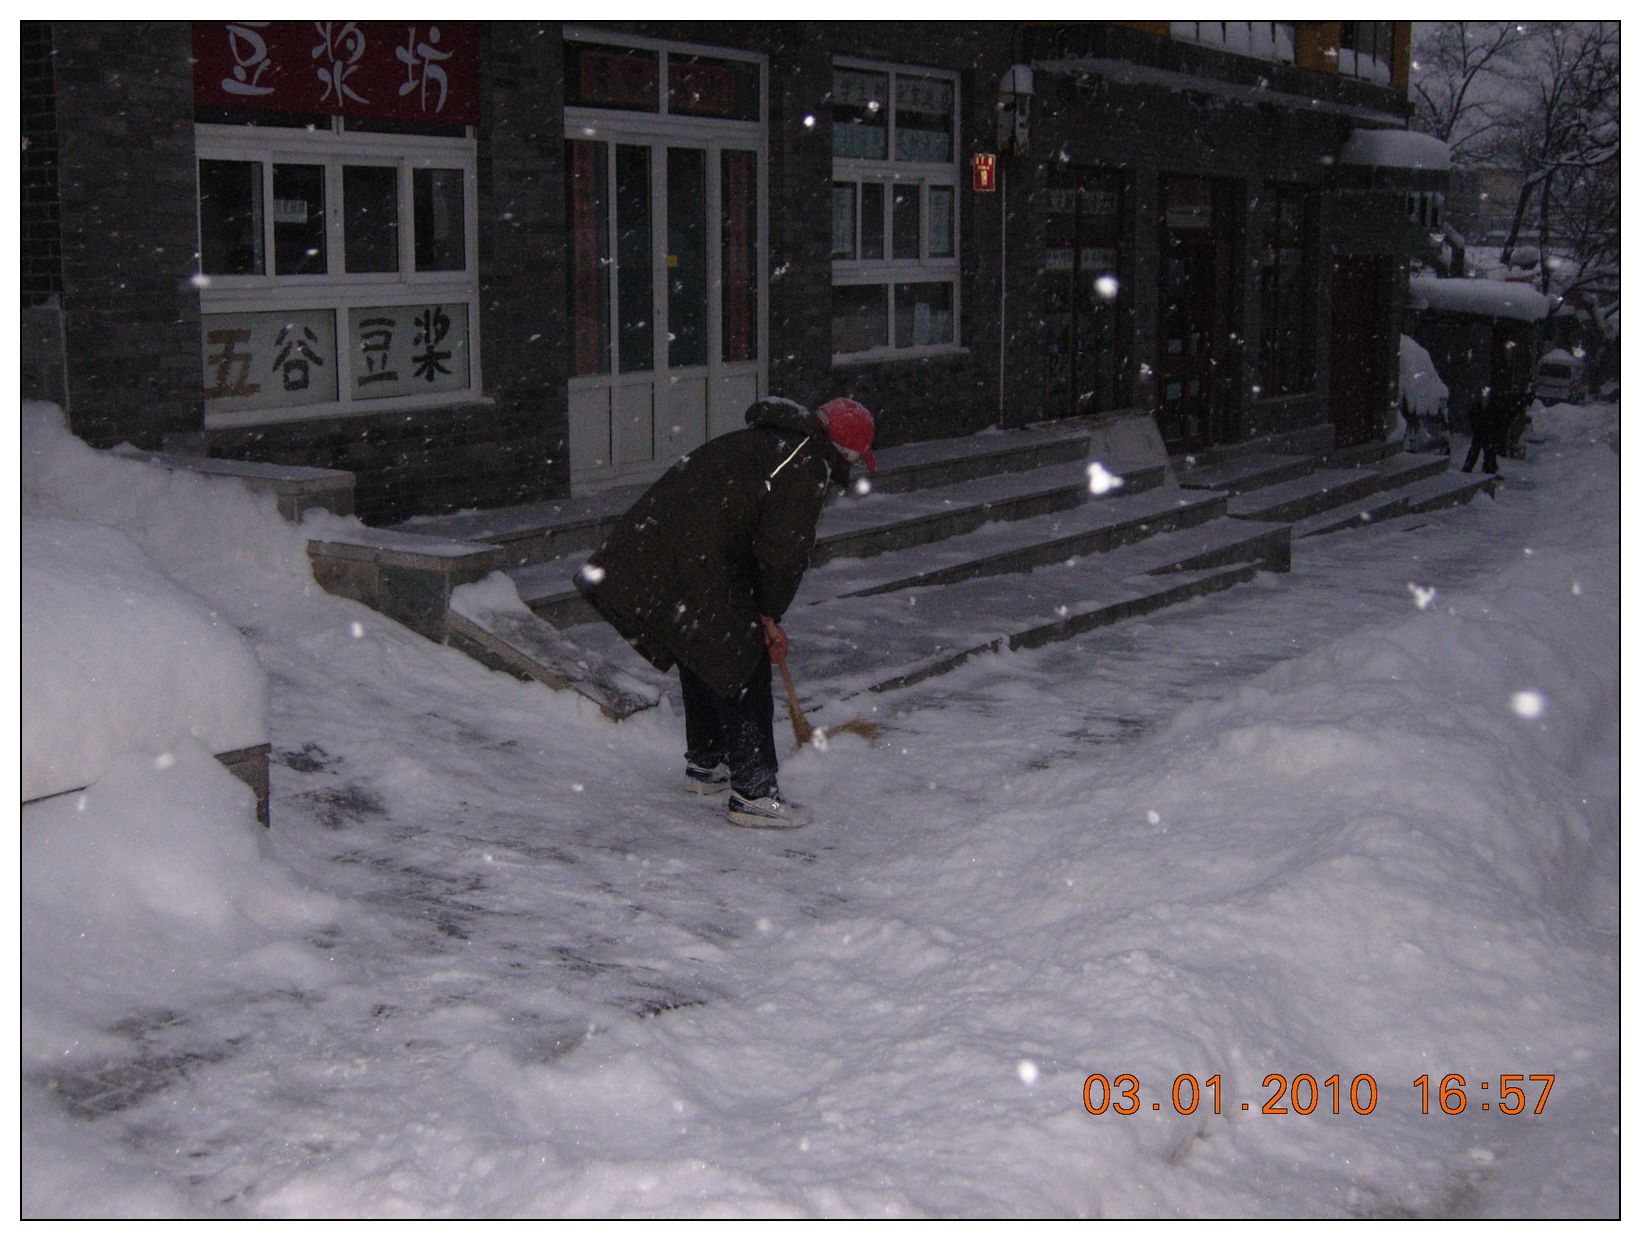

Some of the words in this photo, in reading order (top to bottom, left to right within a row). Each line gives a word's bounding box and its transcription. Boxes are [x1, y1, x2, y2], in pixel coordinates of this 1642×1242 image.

[221, 22, 455, 112] 豆浆坊
[203, 307, 452, 398] 五谷豆浆
